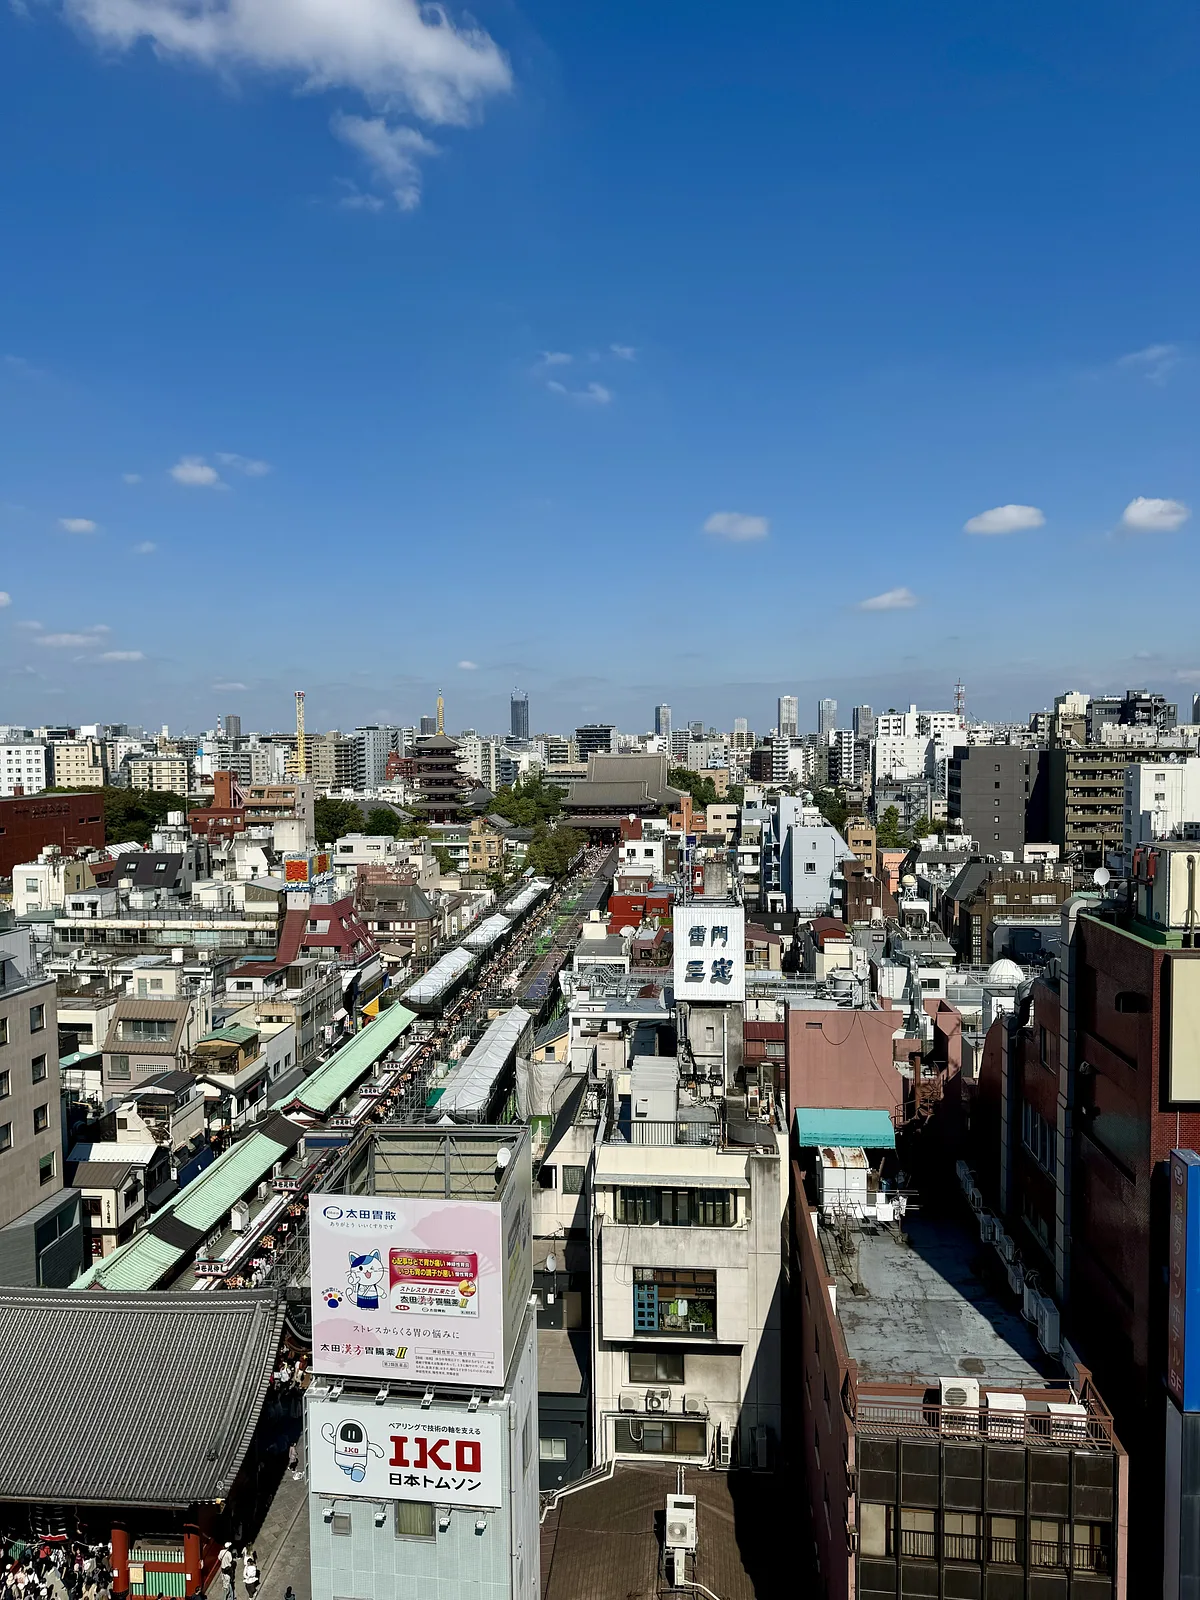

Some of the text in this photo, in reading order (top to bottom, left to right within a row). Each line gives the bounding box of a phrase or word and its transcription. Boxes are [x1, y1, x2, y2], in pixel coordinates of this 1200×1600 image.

[285, 860, 308, 882] 薬
[687, 925, 728, 948] 雷門
[685, 957, 734, 985] 三定
[345, 1208, 397, 1221] 太田胃散
[329, 1221, 355, 1229] ありがとう
[353, 1325, 460, 1340] ストレスからくる胃の悩みに
[1170, 1369, 1183, 1392] 5F
[388, 1422, 481, 1435] ベアリングで技術の軸を支える
[344, 1446, 359, 1454] IKO
[388, 1435, 482, 1473] IKO
[389, 1472, 482, 1492] 日本トムソン
